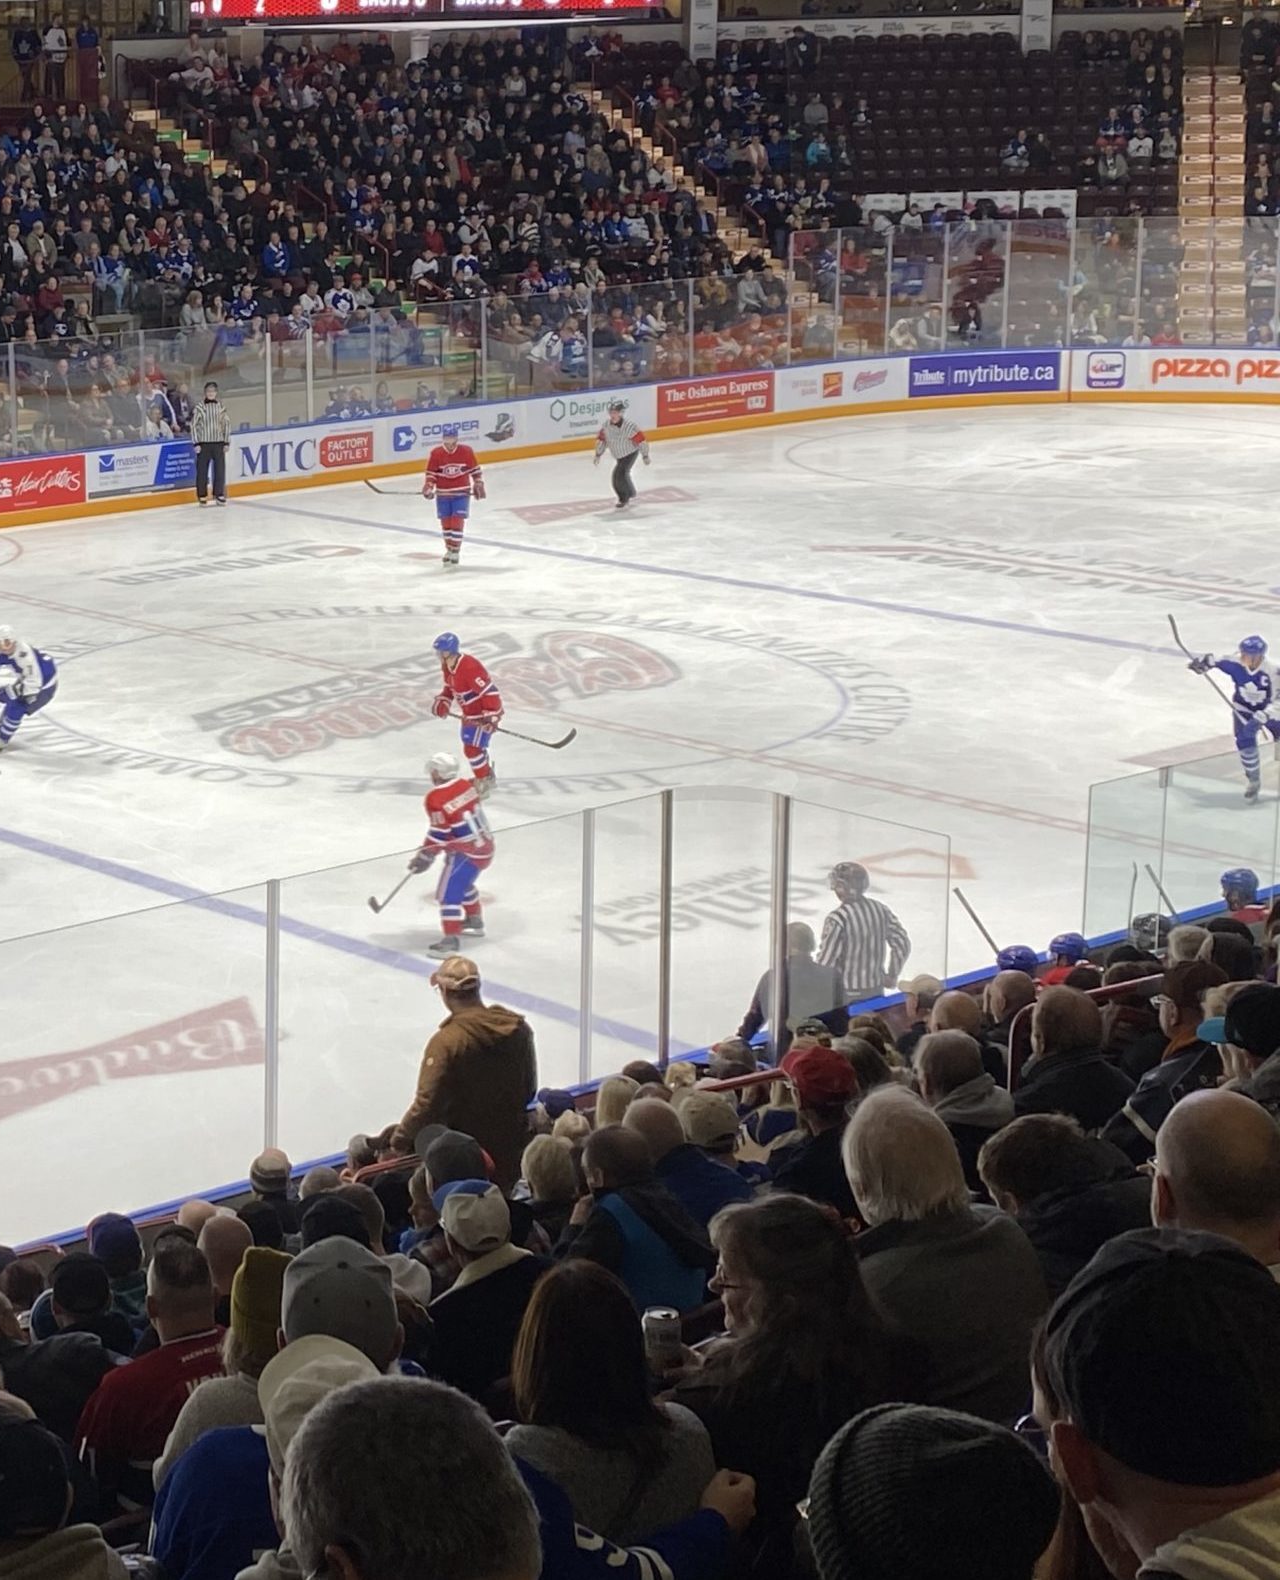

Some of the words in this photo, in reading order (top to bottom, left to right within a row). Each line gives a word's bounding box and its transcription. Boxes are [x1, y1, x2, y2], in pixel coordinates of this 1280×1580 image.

[954, 363, 1055, 387] mytribute.ca
[1152, 358, 1231, 384] pizza
[666, 389, 686, 402] The
[688, 385, 727, 400] Oshawa
[729, 379, 769, 396] Express
[570, 395, 630, 417] Desjars
[327, 437, 369, 450] FACTORY
[328, 448, 369, 462] OUTLET
[240, 438, 317, 478] MTC
[98, 552, 308, 585] PIONEER
[233, 602, 492, 625] TRIBUTE
[519, 605, 891, 678] COMMUNITIES
[811, 683, 912, 745] CENTRE
[474, 676, 486, 689] 6
[335, 769, 666, 797] TRIBTE
